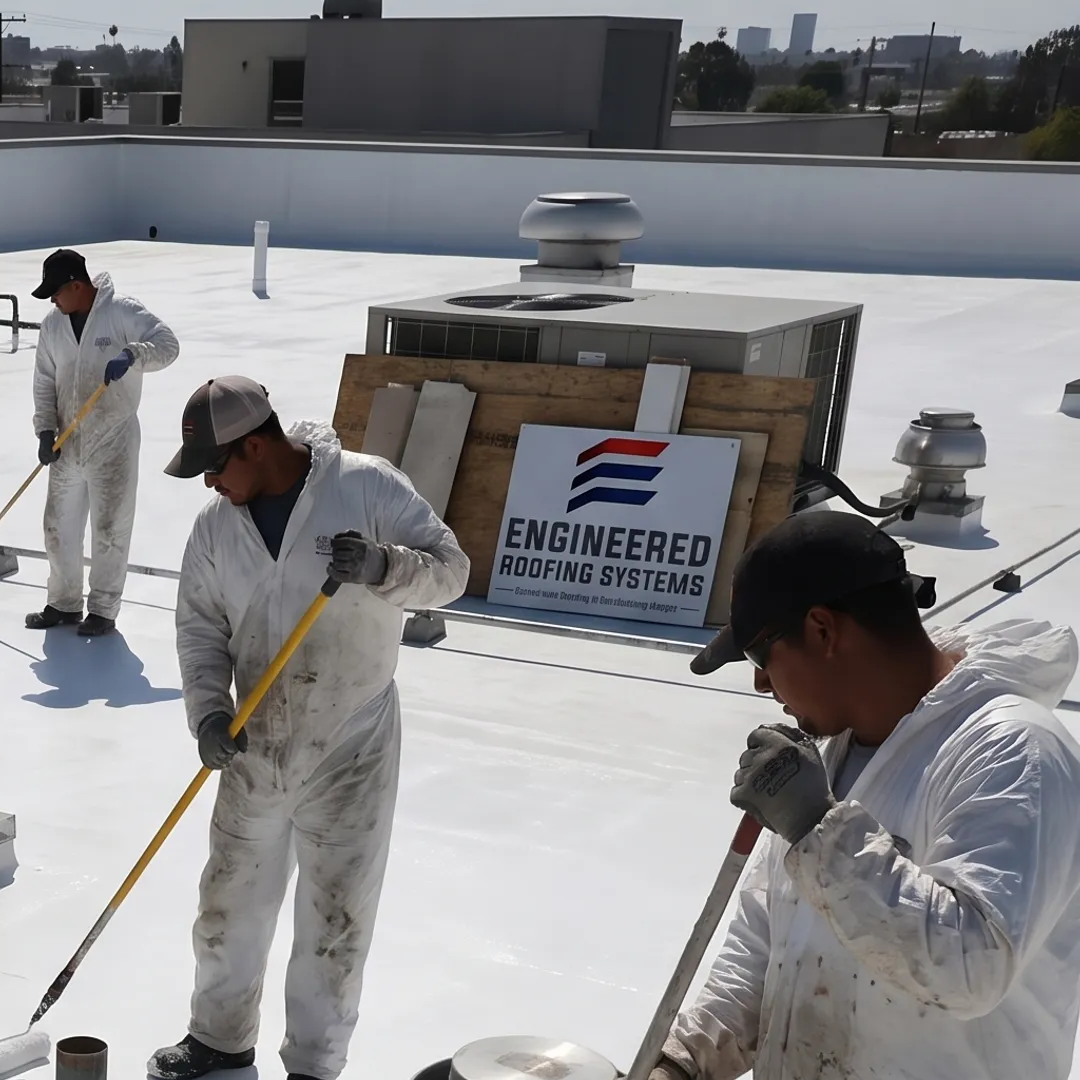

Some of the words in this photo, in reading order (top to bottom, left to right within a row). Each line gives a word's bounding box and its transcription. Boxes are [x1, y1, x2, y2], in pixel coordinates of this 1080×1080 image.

[505, 518, 711, 566] ENGINEERED
[500, 555, 593, 584] ROOFING
[600, 566, 704, 596] SYSTEMS
